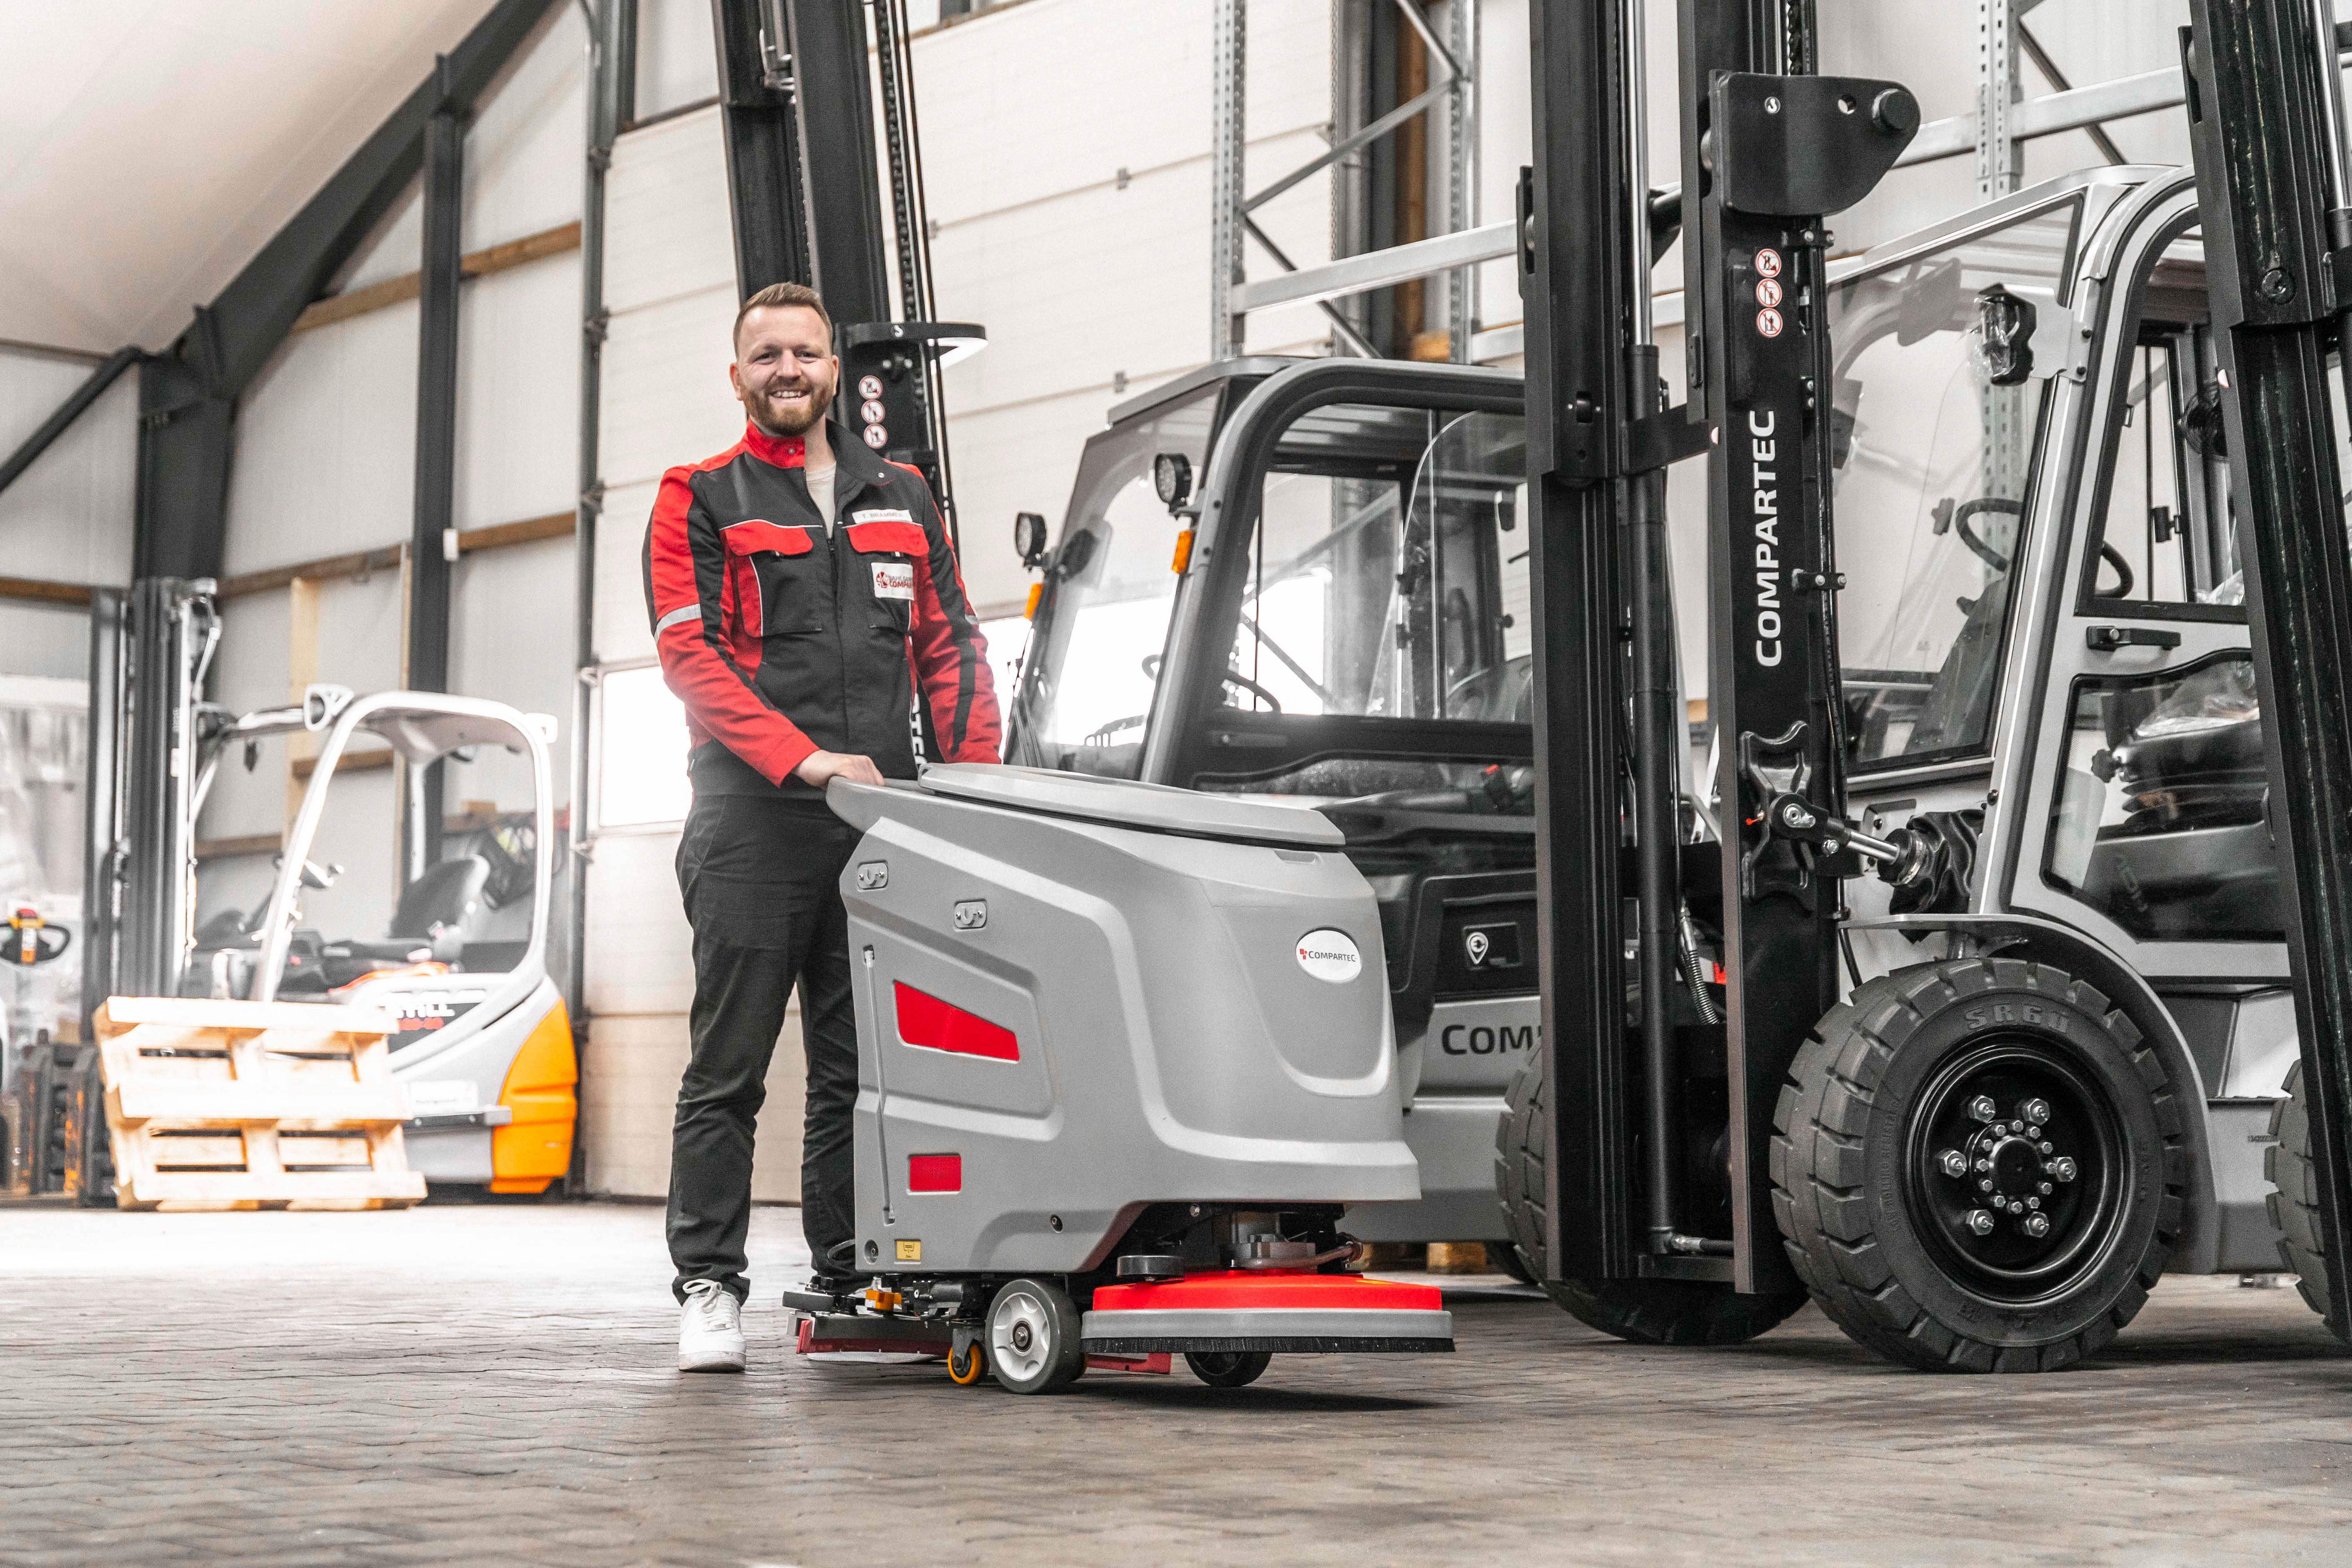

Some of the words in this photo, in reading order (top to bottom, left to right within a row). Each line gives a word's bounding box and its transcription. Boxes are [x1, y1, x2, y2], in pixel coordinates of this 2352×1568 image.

[1749, 410, 1782, 667] COMPARTEC
[1308, 951, 1357, 962] COMPARTEC
[1441, 1024, 1542, 1056] COM
